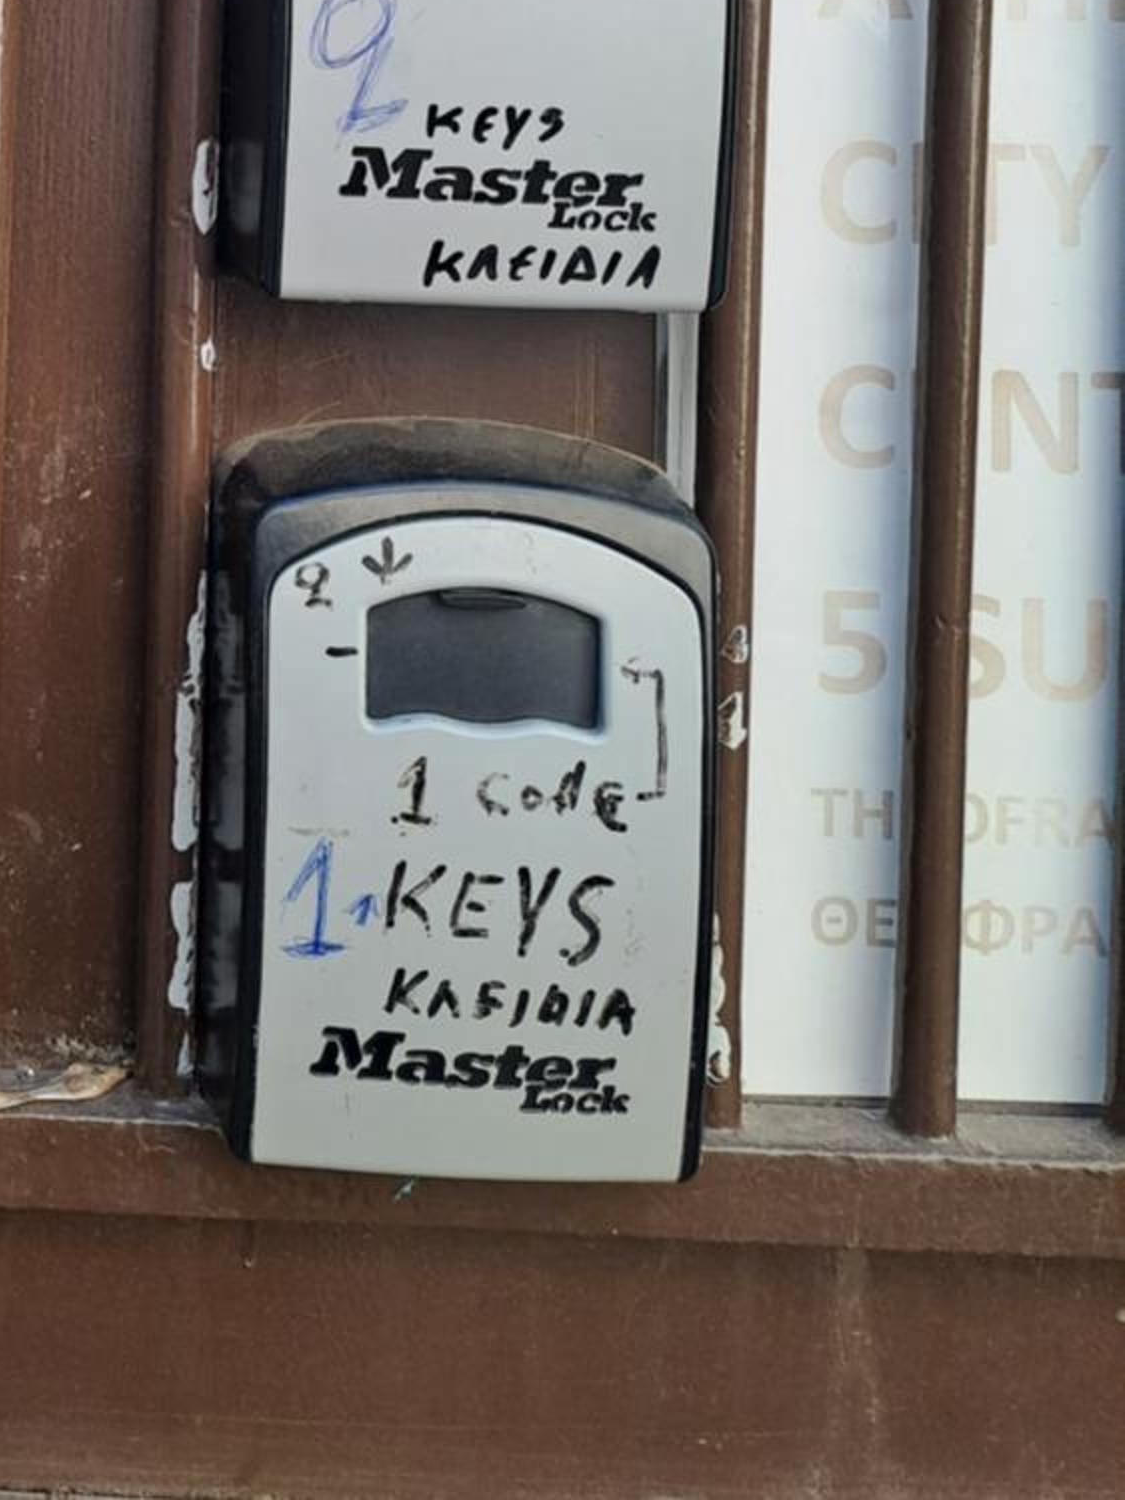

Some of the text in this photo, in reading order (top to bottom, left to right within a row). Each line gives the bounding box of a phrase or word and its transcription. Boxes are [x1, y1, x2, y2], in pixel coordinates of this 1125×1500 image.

[338, 147, 645, 208] Master
[547, 202, 657, 232] Lock
[819, 590, 888, 695] 5
[390, 755, 433, 826] 1
[279, 836, 347, 957] 1
[383, 859, 616, 967] KEYS
[309, 1026, 617, 1091] Master
[520, 1086, 631, 1115] Lock
